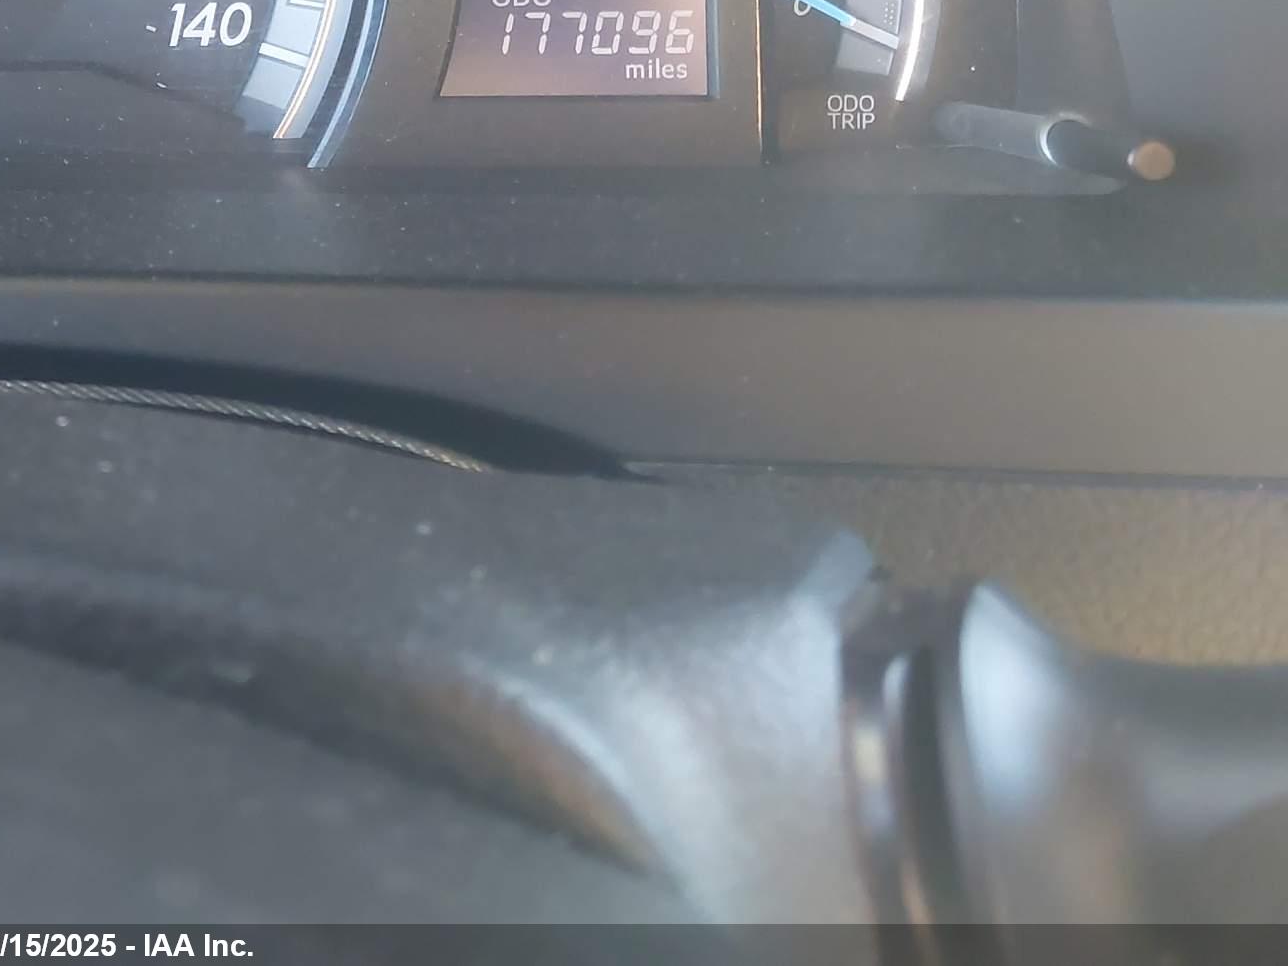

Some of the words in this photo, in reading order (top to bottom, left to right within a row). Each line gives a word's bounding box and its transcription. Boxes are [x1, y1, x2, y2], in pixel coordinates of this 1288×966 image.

[169, 1, 253, 48] 140
[501, 10, 694, 55] 177096
[625, 59, 688, 80] miles
[827, 95, 874, 112] ODO
[827, 111, 875, 130] TRIP
